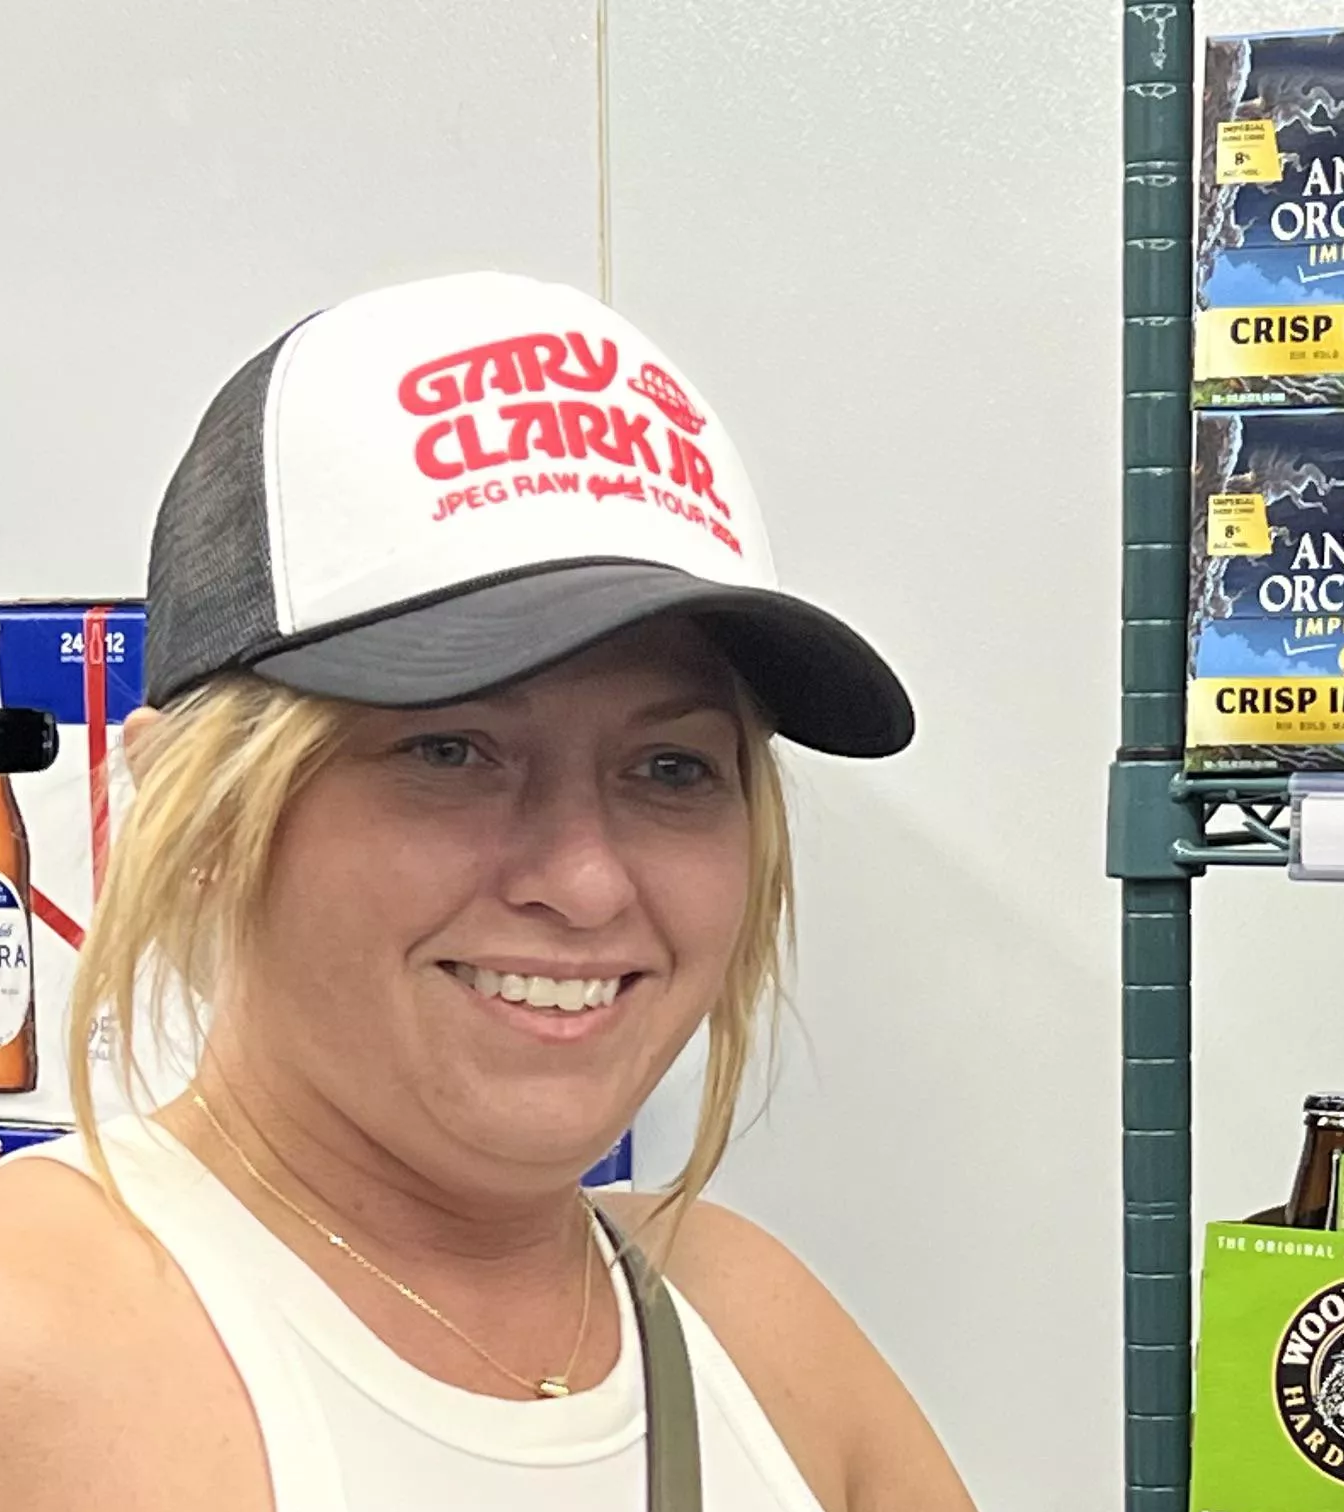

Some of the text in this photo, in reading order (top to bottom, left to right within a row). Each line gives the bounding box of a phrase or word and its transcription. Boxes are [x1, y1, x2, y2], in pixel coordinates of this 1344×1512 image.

[1230, 315, 1333, 346] CRISP
[397, 331, 619, 416] GARY
[413, 400, 661, 481] CLARK
[432, 471, 709, 530] JPEG RAW TOUR
[60, 631, 125, 654] 24 12
[1215, 686, 1318, 715] CRISP
[1217, 1236, 1246, 1252] THE
[1254, 1238, 1335, 1260] ORIGINAL
[1282, 1385, 1344, 1468] HARD
